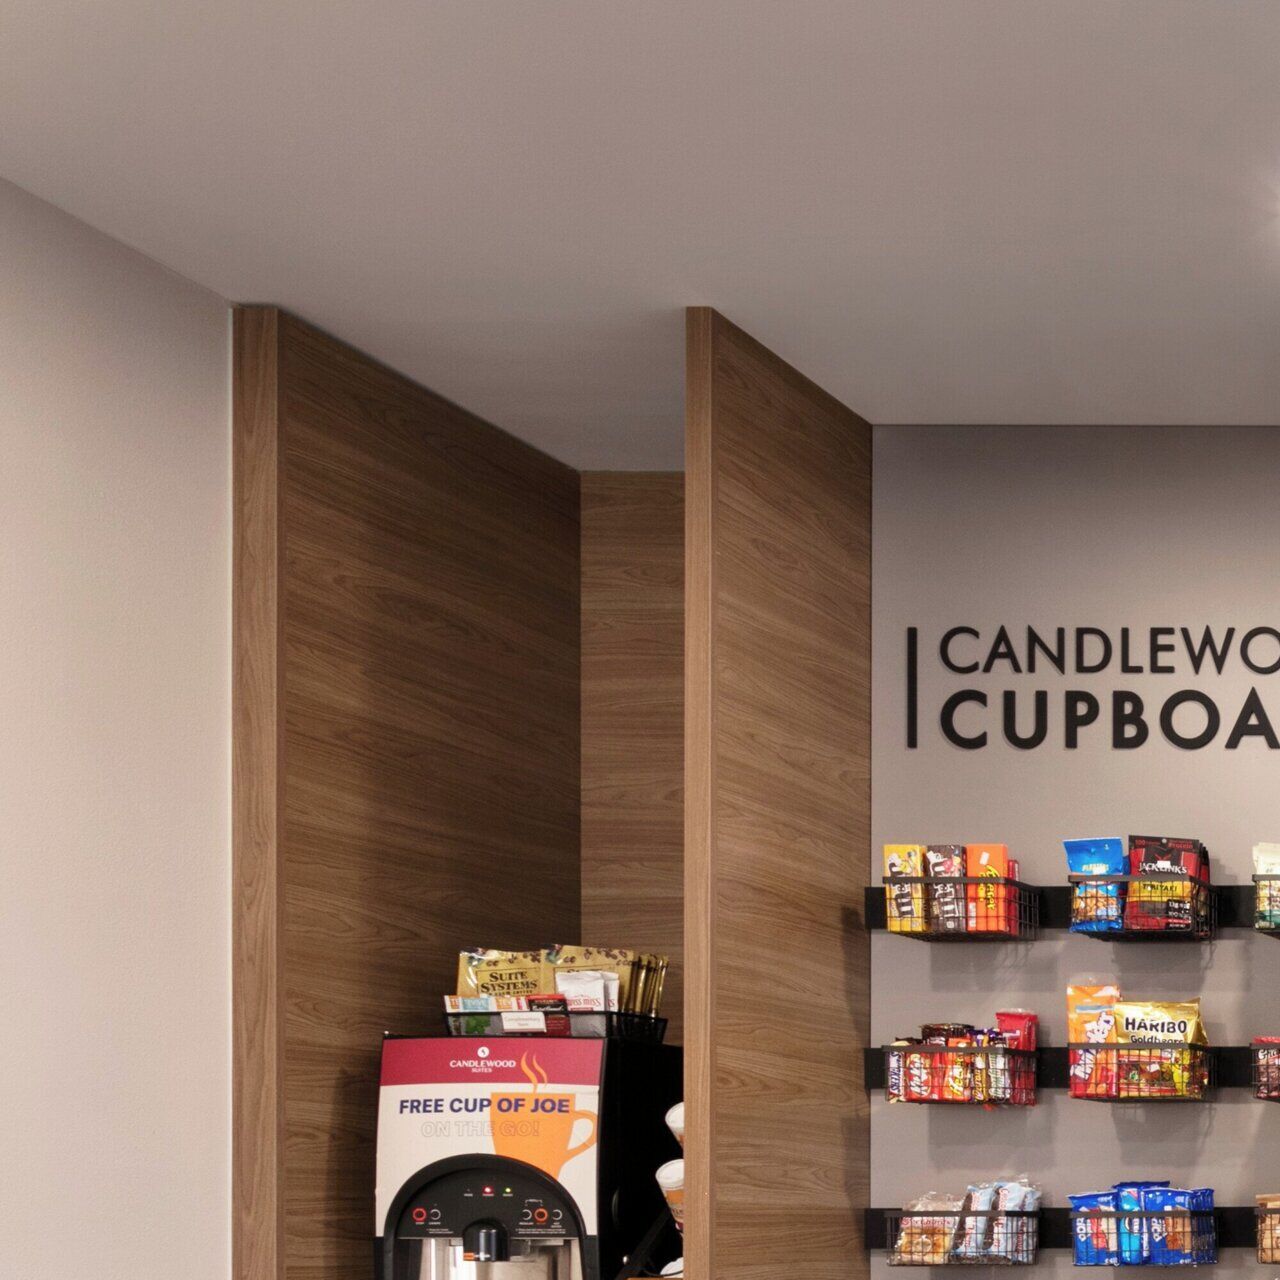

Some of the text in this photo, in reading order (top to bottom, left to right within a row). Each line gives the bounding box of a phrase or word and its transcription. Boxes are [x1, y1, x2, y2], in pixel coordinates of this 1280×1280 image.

[489, 971, 528, 982] SUITE
[480, 980, 538, 992] SYSTEMS
[1125, 1017, 1187, 1033] HARIBO
[450, 1060, 516, 1068] CANDLEWOOD
[399, 1098, 570, 1114] FREE CUP OF JOE
[421, 1121, 540, 1137] ON THE GO!
